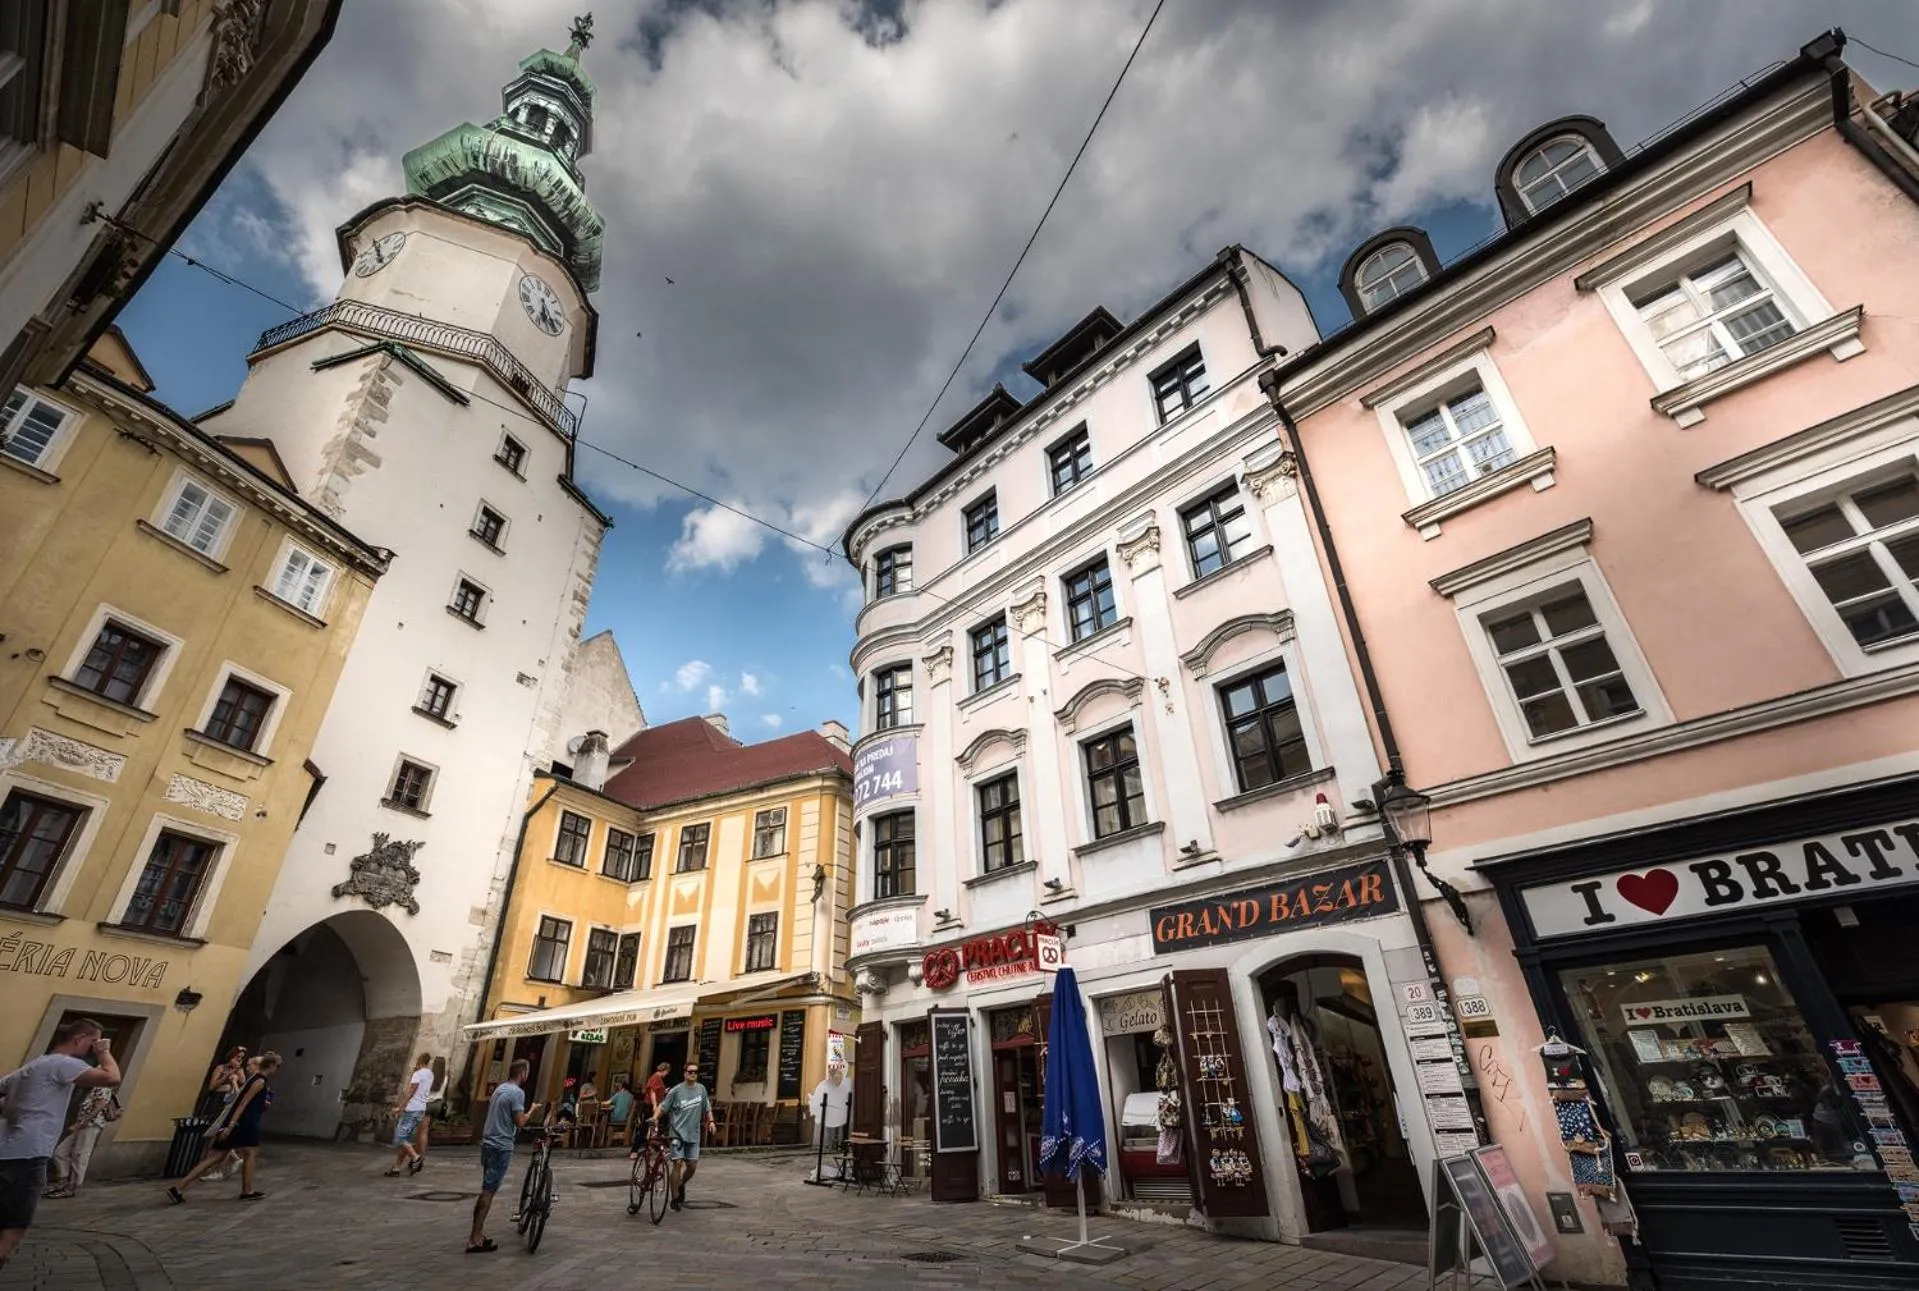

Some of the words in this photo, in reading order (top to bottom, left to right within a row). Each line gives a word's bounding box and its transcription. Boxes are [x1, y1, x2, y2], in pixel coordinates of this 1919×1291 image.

[873, 770, 902, 794] 744
[1156, 899, 1260, 943] GRAND
[1268, 873, 1385, 922] BAZAR
[1571, 881, 1616, 926] I
[76, 950, 169, 989] NOVA
[1408, 986, 1422, 999] 20
[1413, 1006, 1433, 1020] 389
[1464, 1000, 1486, 1014] 388
[1625, 1008, 1637, 1020] I
[1652, 1002, 1744, 1018] Bratislava
[727, 1021, 745, 1031] Live
[746, 1017, 773, 1029] music
[1120, 1009, 1158, 1032] Gelato
